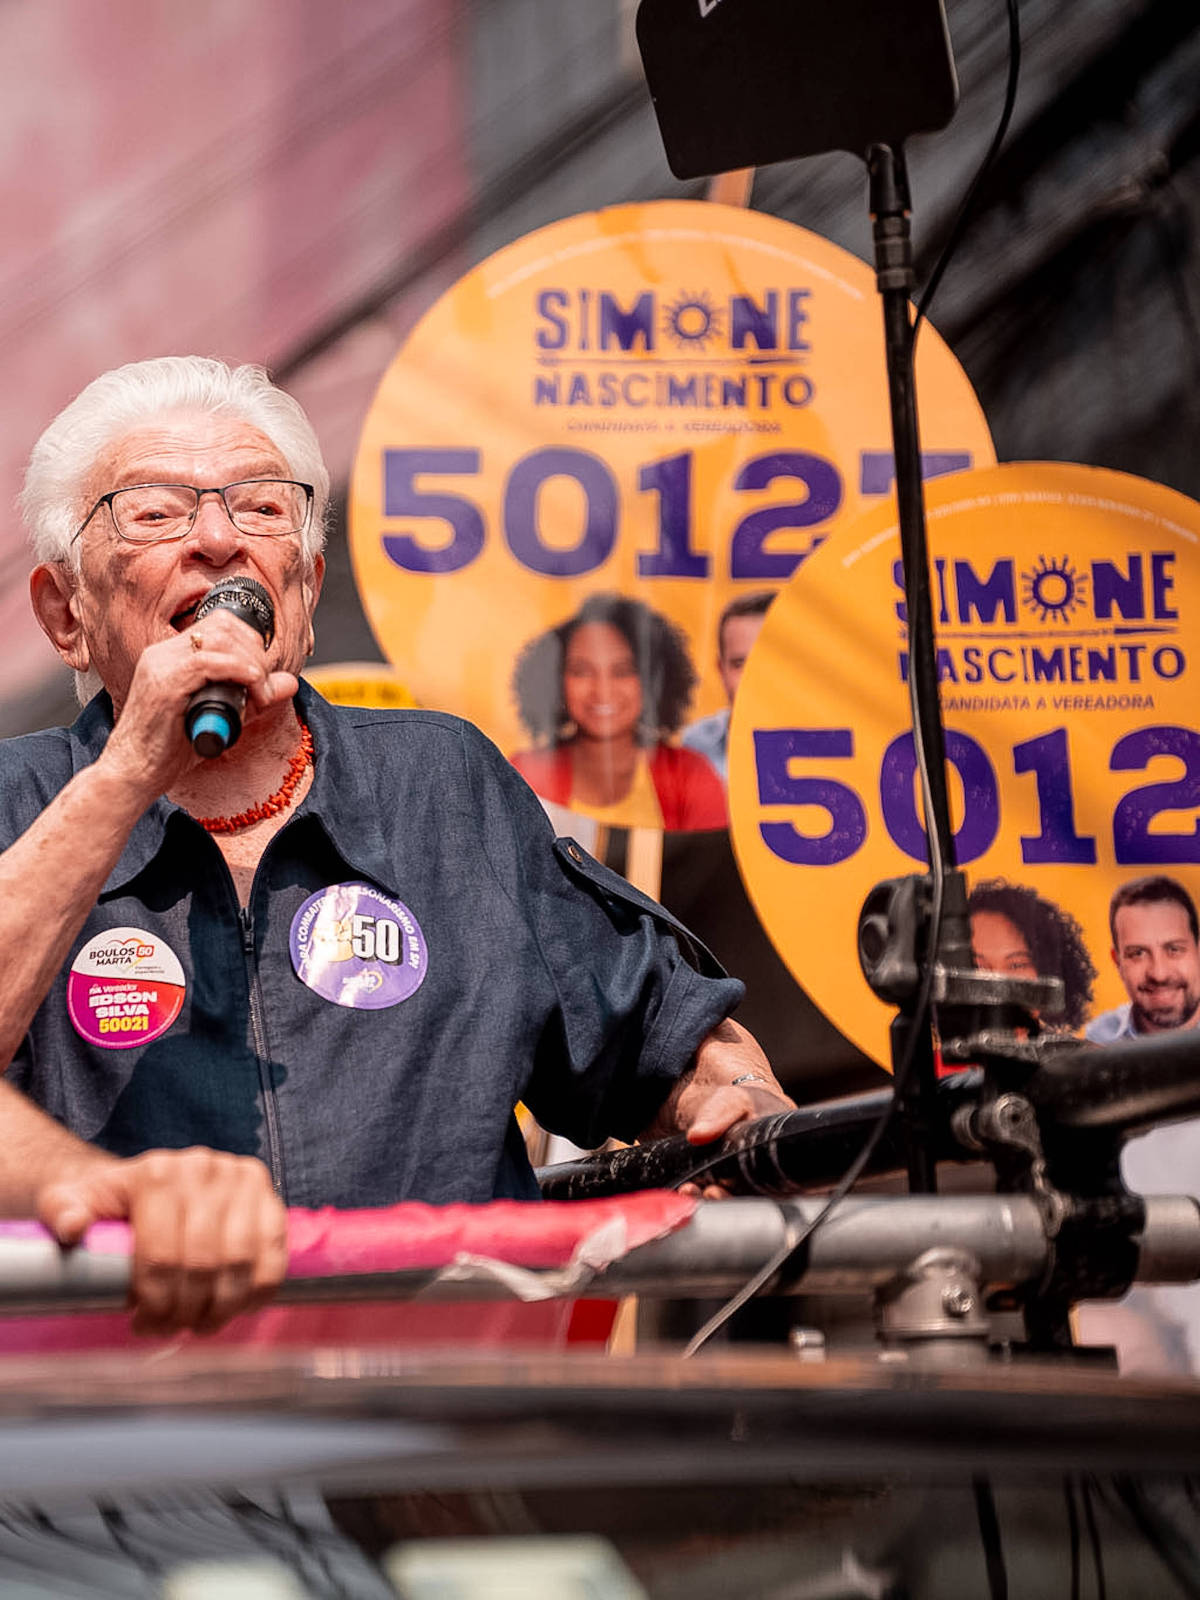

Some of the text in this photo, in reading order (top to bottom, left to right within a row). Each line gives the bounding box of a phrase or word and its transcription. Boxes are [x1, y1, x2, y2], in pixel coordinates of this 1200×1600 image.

[535, 287, 813, 352] SIMONE
[533, 372, 815, 409] NASCIMENTO
[1036, 695, 1047, 711] A
[1052, 693, 1155, 711] VEREADORA
[352, 914, 401, 963] 50
[89, 946, 153, 960] BOULOS 50
[96, 957, 132, 966] MARTA
[89, 991, 158, 1007] EDSON
[95, 1004, 150, 1018] SILVA
[99, 1016, 149, 1033] 50021
